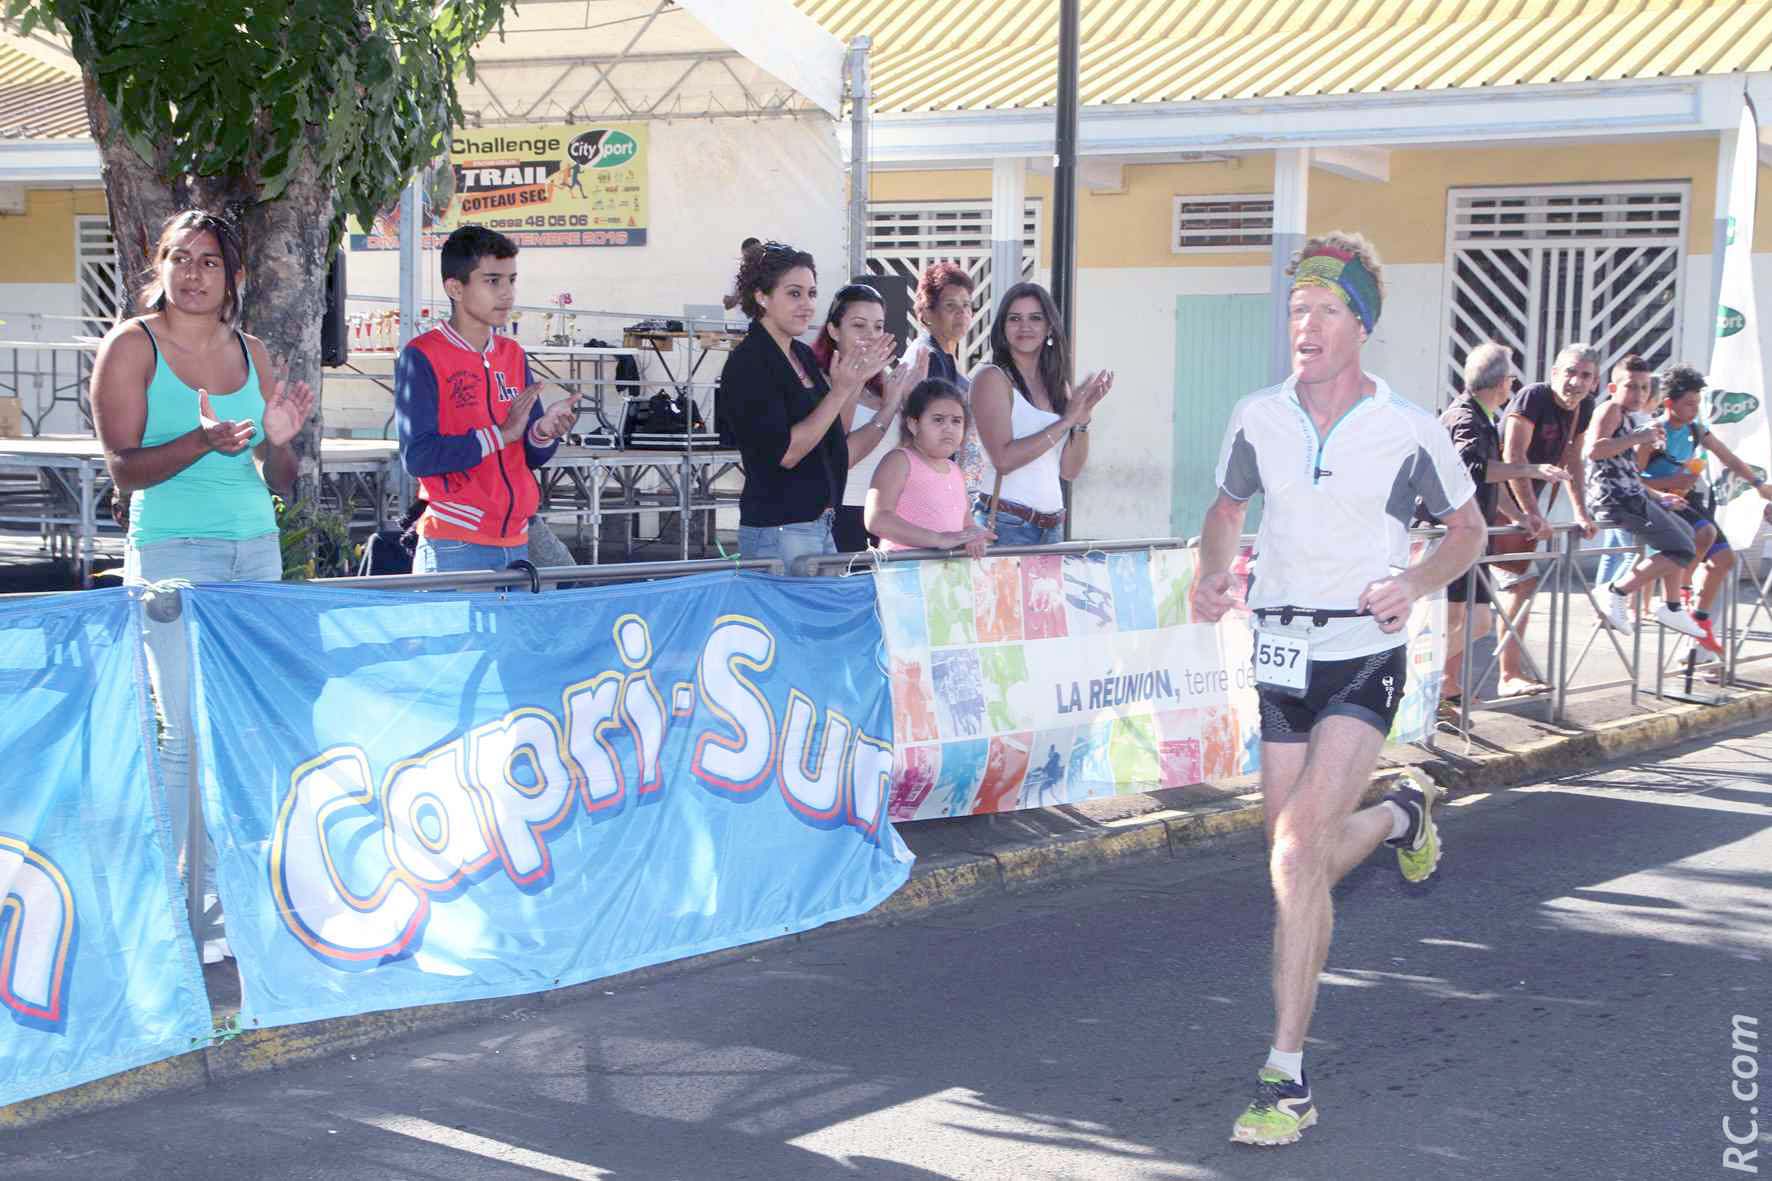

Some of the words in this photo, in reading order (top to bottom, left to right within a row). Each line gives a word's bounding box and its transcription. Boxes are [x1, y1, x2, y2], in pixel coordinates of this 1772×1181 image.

[450, 137, 561, 155] Challenge
[462, 193, 516, 212] COTEAU
[519, 188, 548, 204] SEC
[525, 215, 545, 227] 48
[548, 215, 567, 226] 05
[569, 214, 588, 226] 06
[1259, 644, 1301, 669] 557
[1056, 681, 1083, 714] LA
[1088, 669, 1181, 710] RÉUNION,
[1184, 667, 1229, 696] terre
